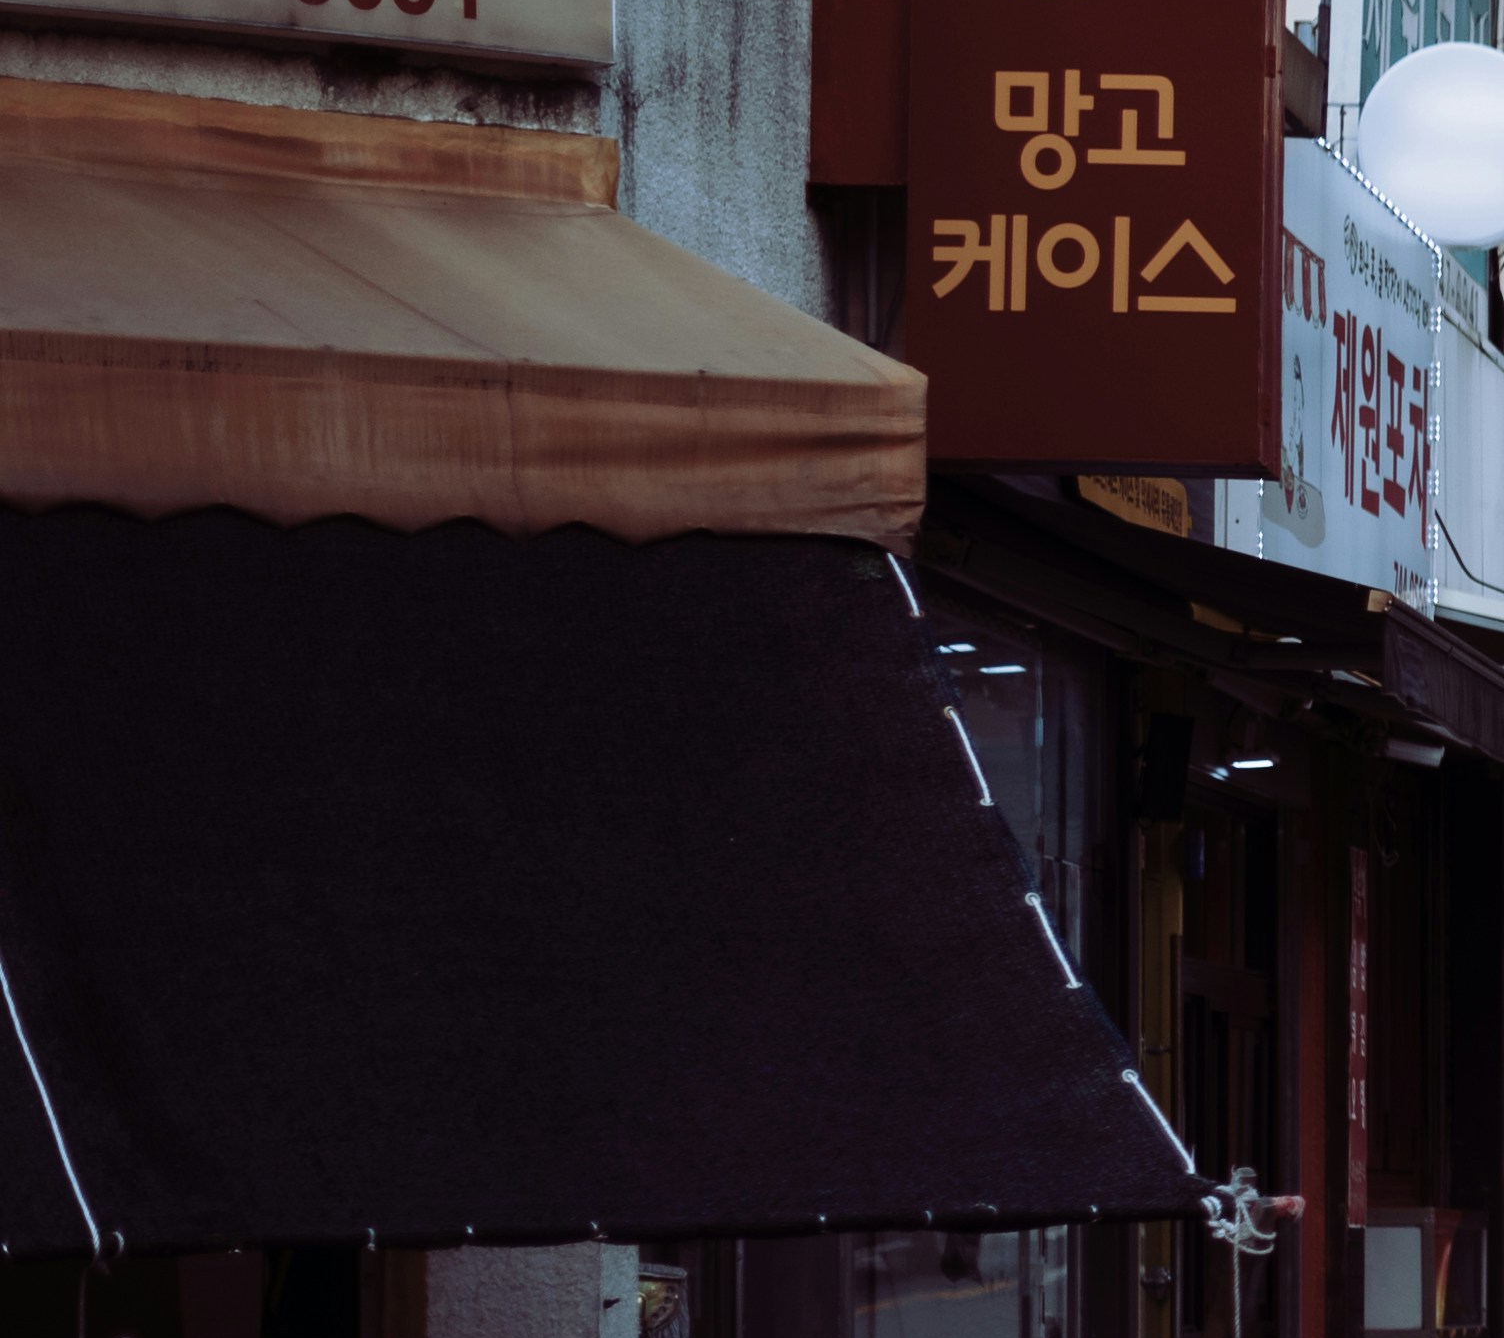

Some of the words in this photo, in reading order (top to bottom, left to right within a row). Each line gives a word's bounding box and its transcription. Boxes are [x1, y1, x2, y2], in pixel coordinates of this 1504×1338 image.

[994, 69, 1188, 191] 망고
[931, 213, 1237, 314] 케이스
[1331, 309, 1433, 551] 제원포차
